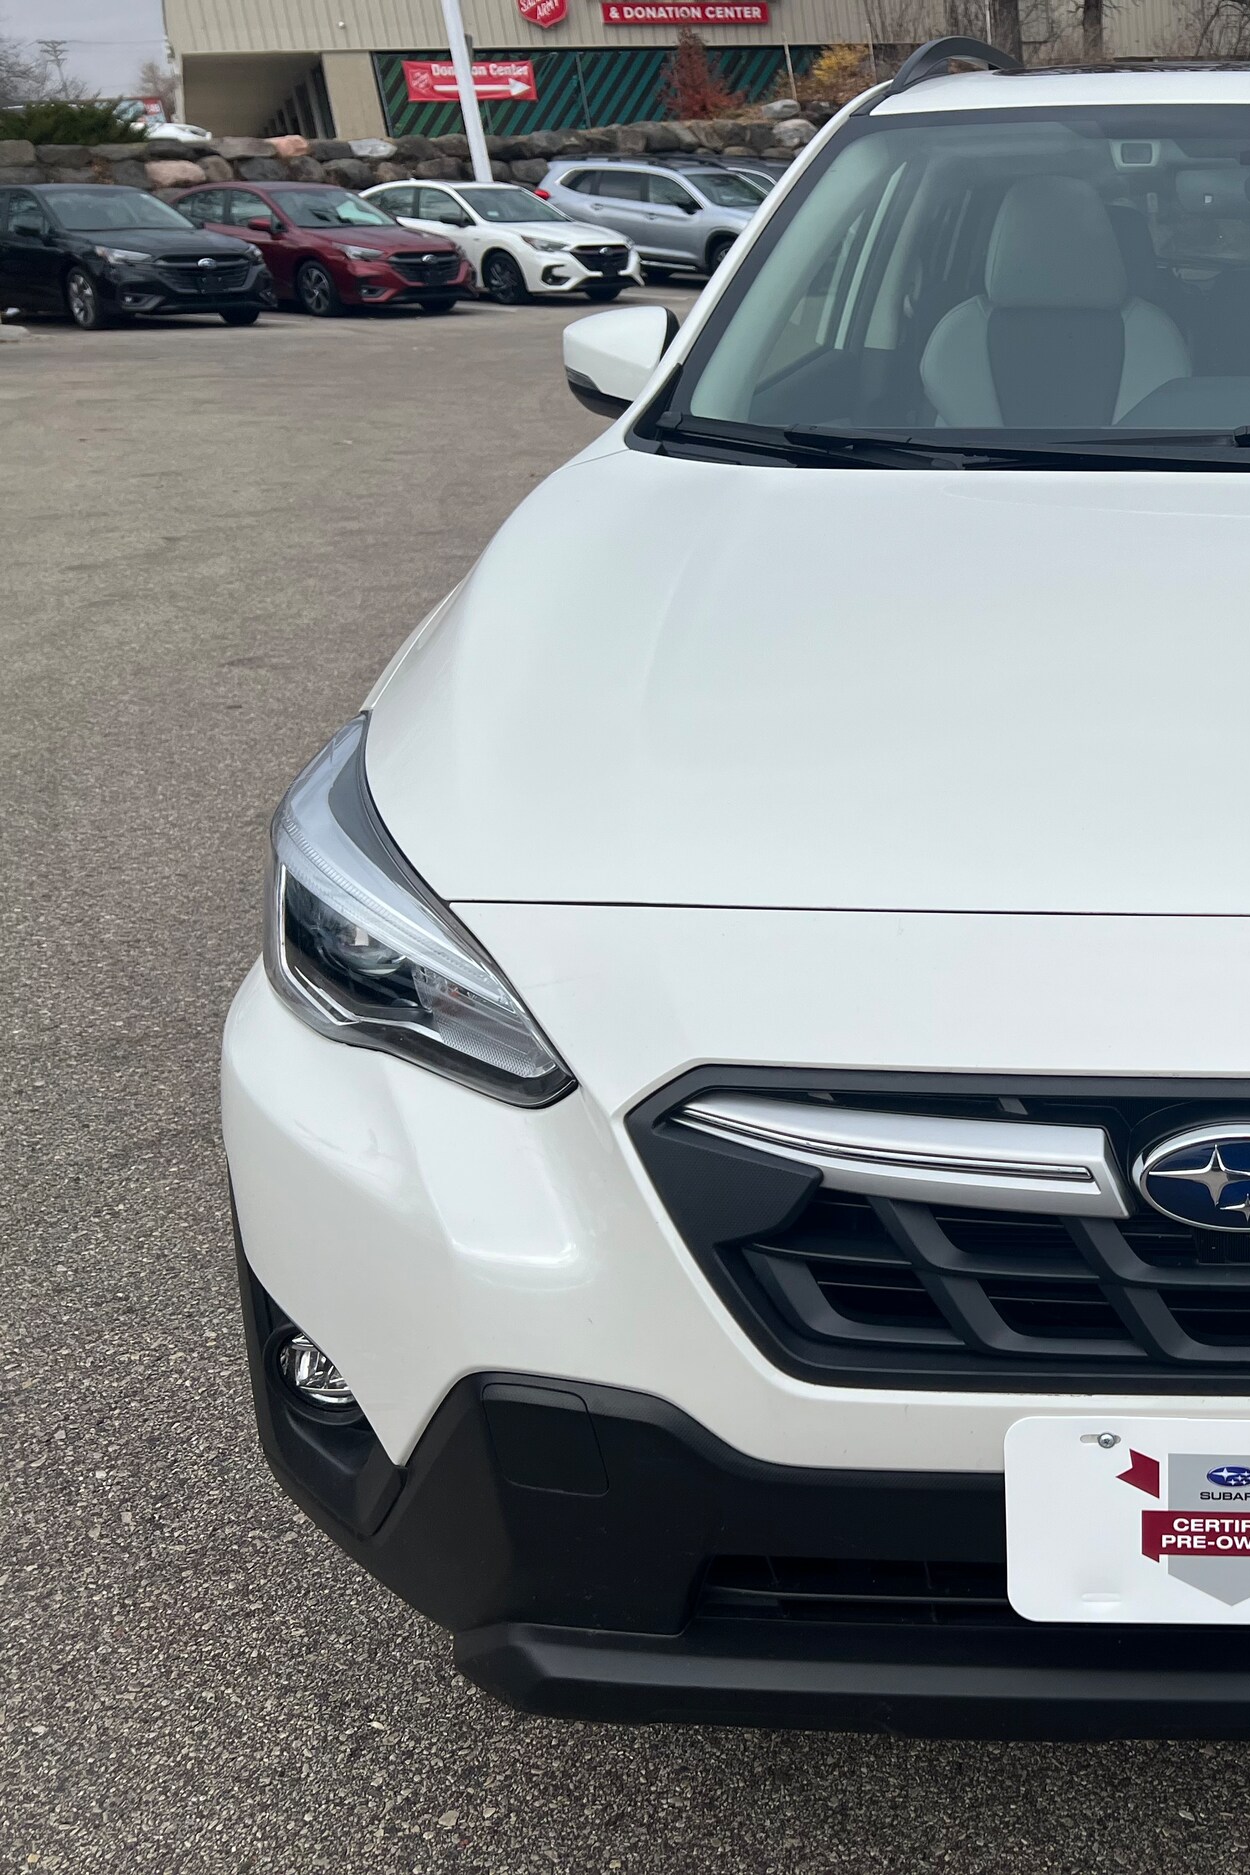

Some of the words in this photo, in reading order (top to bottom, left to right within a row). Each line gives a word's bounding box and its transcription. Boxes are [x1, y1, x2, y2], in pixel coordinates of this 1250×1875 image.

[609, 7, 620, 19] &
[623, 6, 702, 19] DONATION
[705, 6, 762, 19] CENTER
[431, 63, 487, 76] Donon
[489, 63, 529, 76] Center
